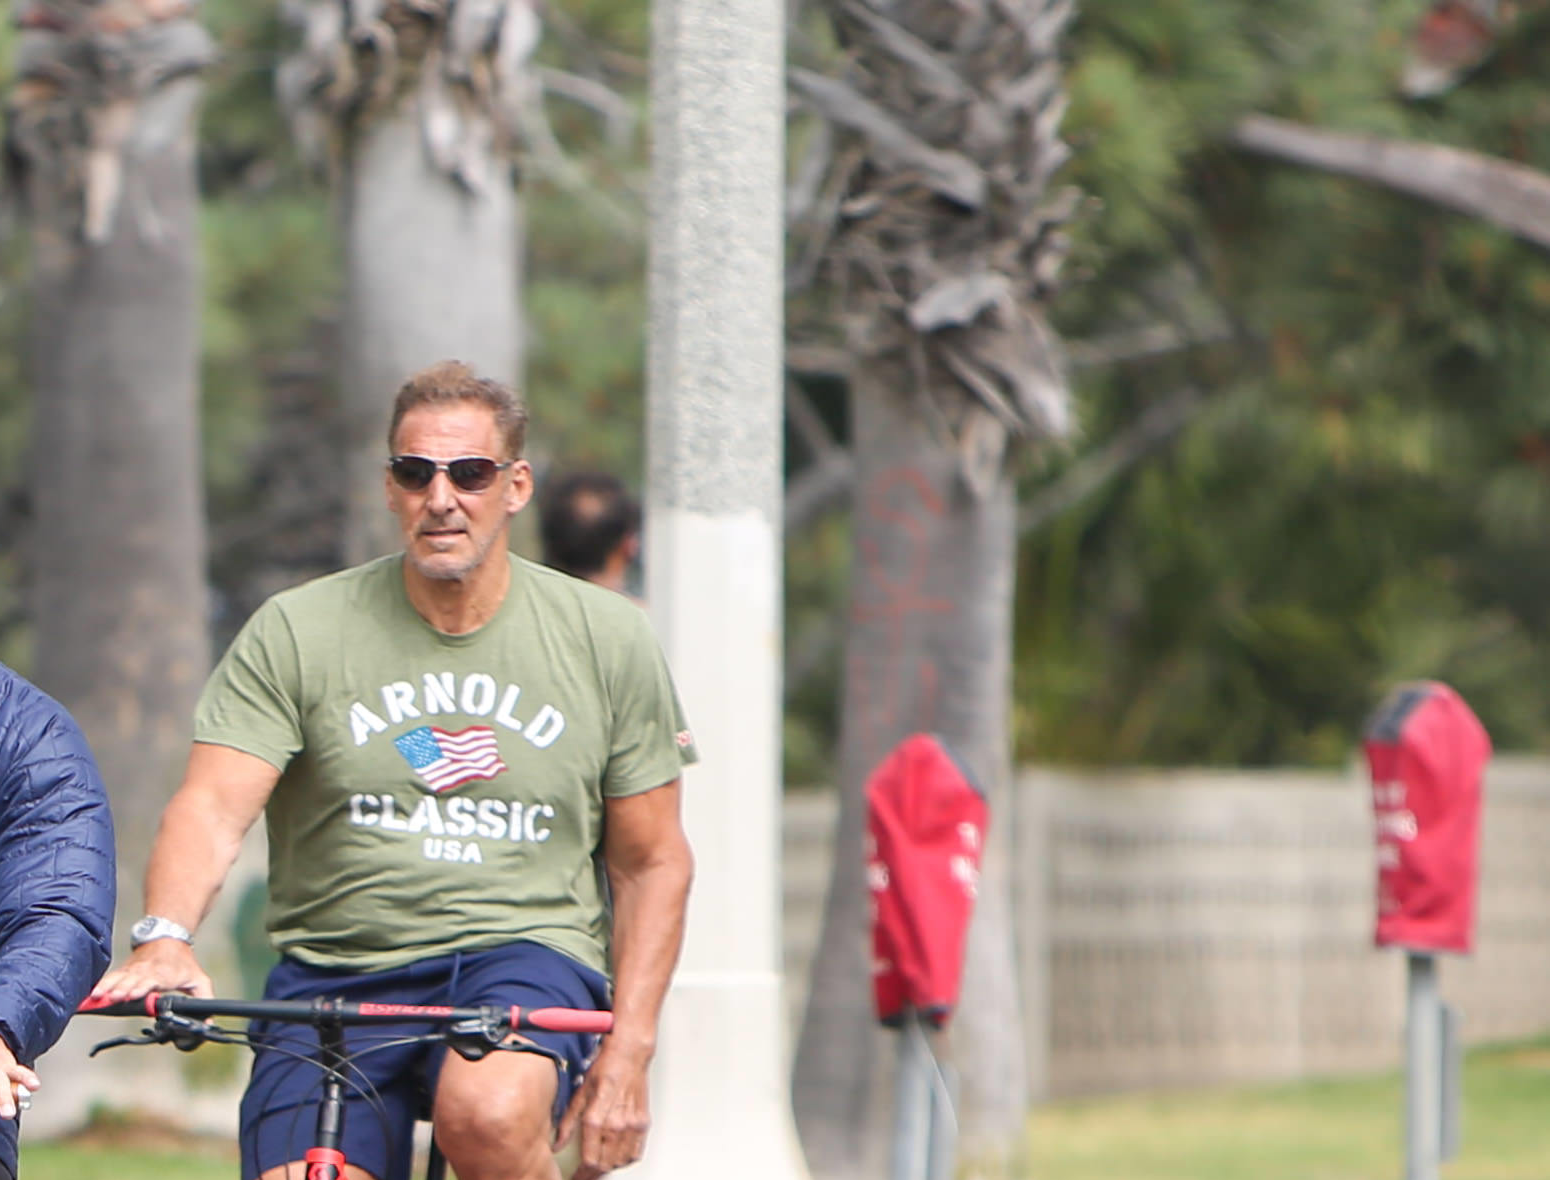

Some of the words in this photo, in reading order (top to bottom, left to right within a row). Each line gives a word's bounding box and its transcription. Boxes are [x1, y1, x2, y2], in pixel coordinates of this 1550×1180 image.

[350, 672, 565, 748] ARNOLD
[351, 793, 554, 842] CLASSIC
[423, 838, 483, 864] USA
